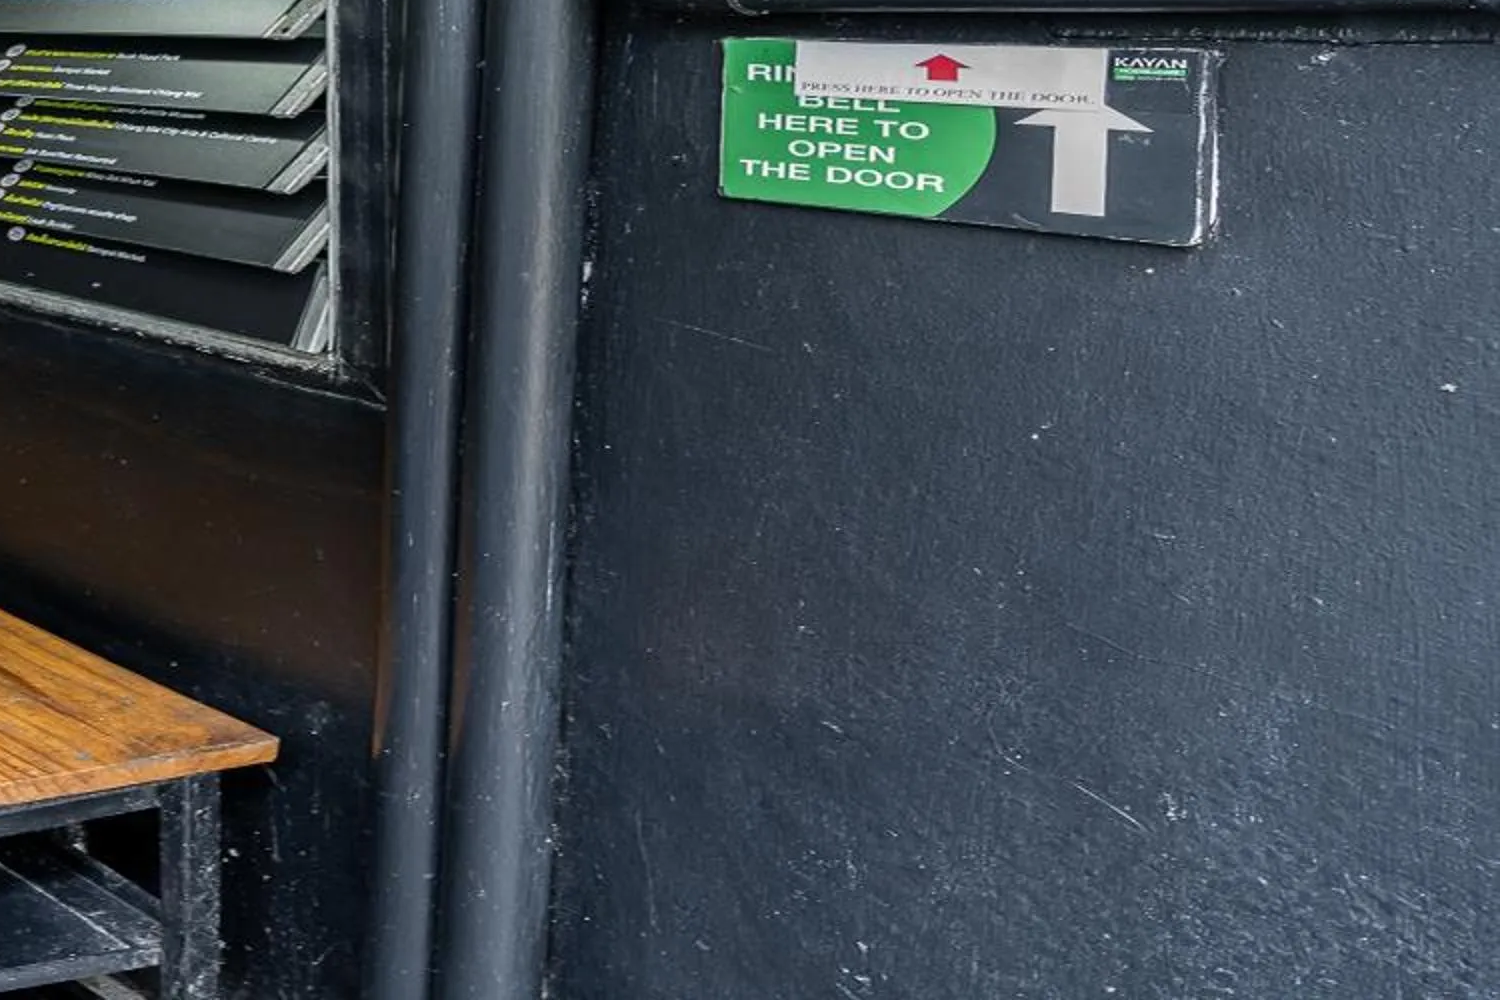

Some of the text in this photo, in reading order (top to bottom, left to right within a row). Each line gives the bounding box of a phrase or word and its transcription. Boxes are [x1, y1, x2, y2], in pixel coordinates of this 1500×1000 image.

[747, 63, 796, 82] RI
[801, 81, 850, 93] PRESS
[854, 84, 900, 95] HERE
[907, 86, 931, 97] TO
[932, 87, 983, 99] OPEN
[798, 95, 901, 113] BELL
[758, 112, 930, 140] HERE TO
[788, 139, 896, 164] OPEN
[739, 159, 945, 193] THE DOOR
